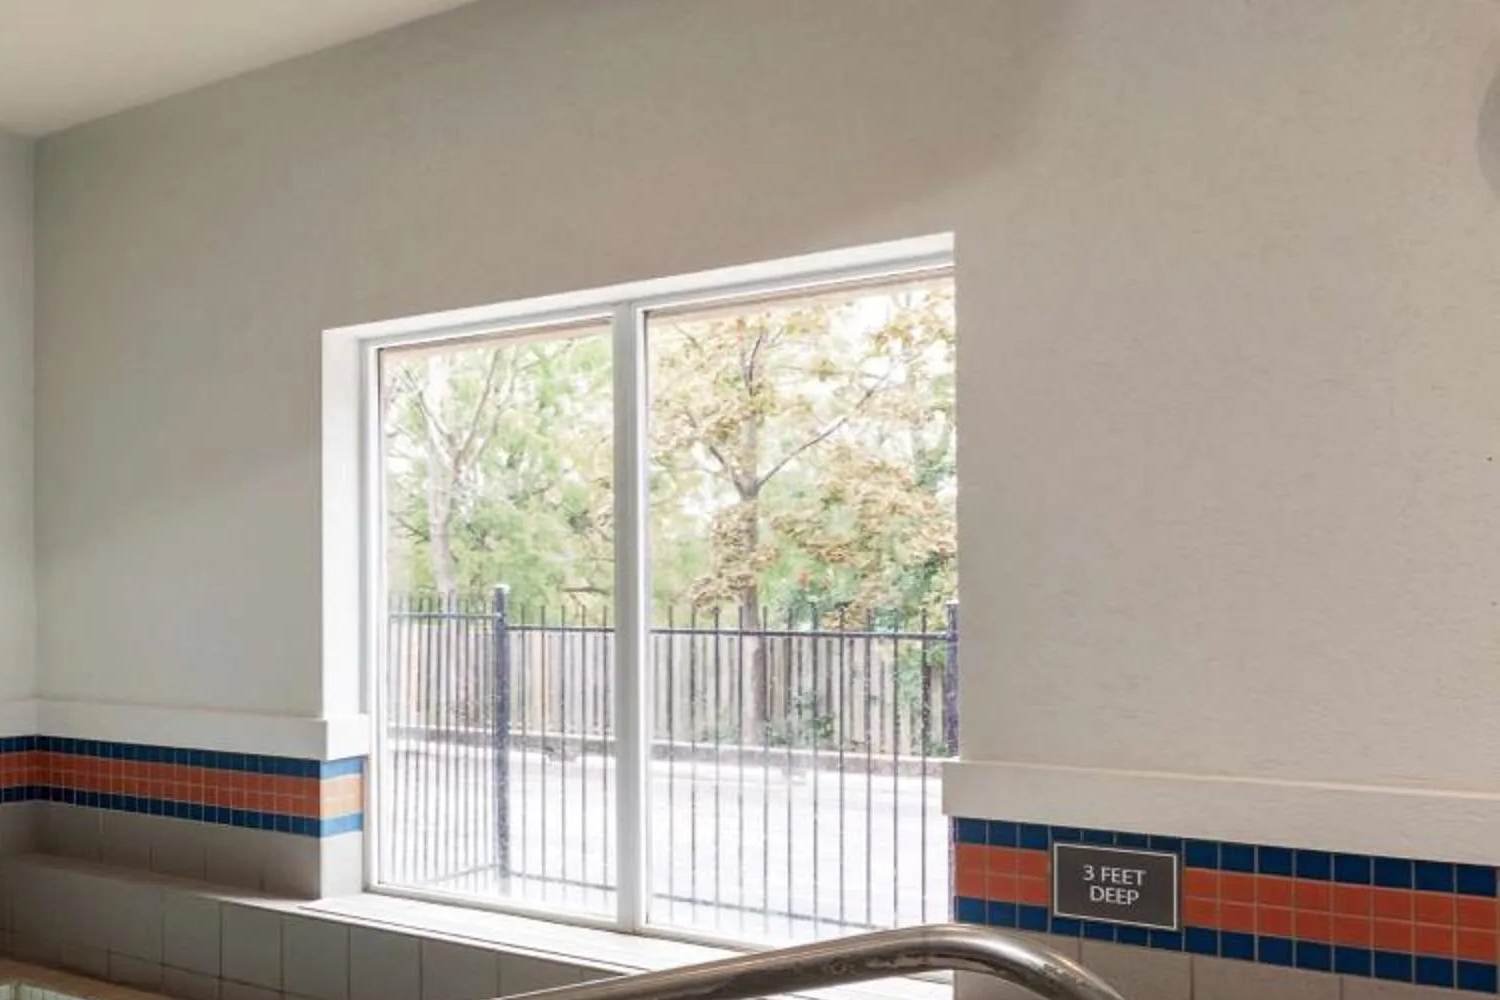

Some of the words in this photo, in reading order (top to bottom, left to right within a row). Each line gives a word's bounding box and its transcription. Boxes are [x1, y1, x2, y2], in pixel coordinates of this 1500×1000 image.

[1083, 864, 1095, 881] 3
[1101, 866, 1147, 886] FEET
[1090, 885, 1140, 905] DEEP
